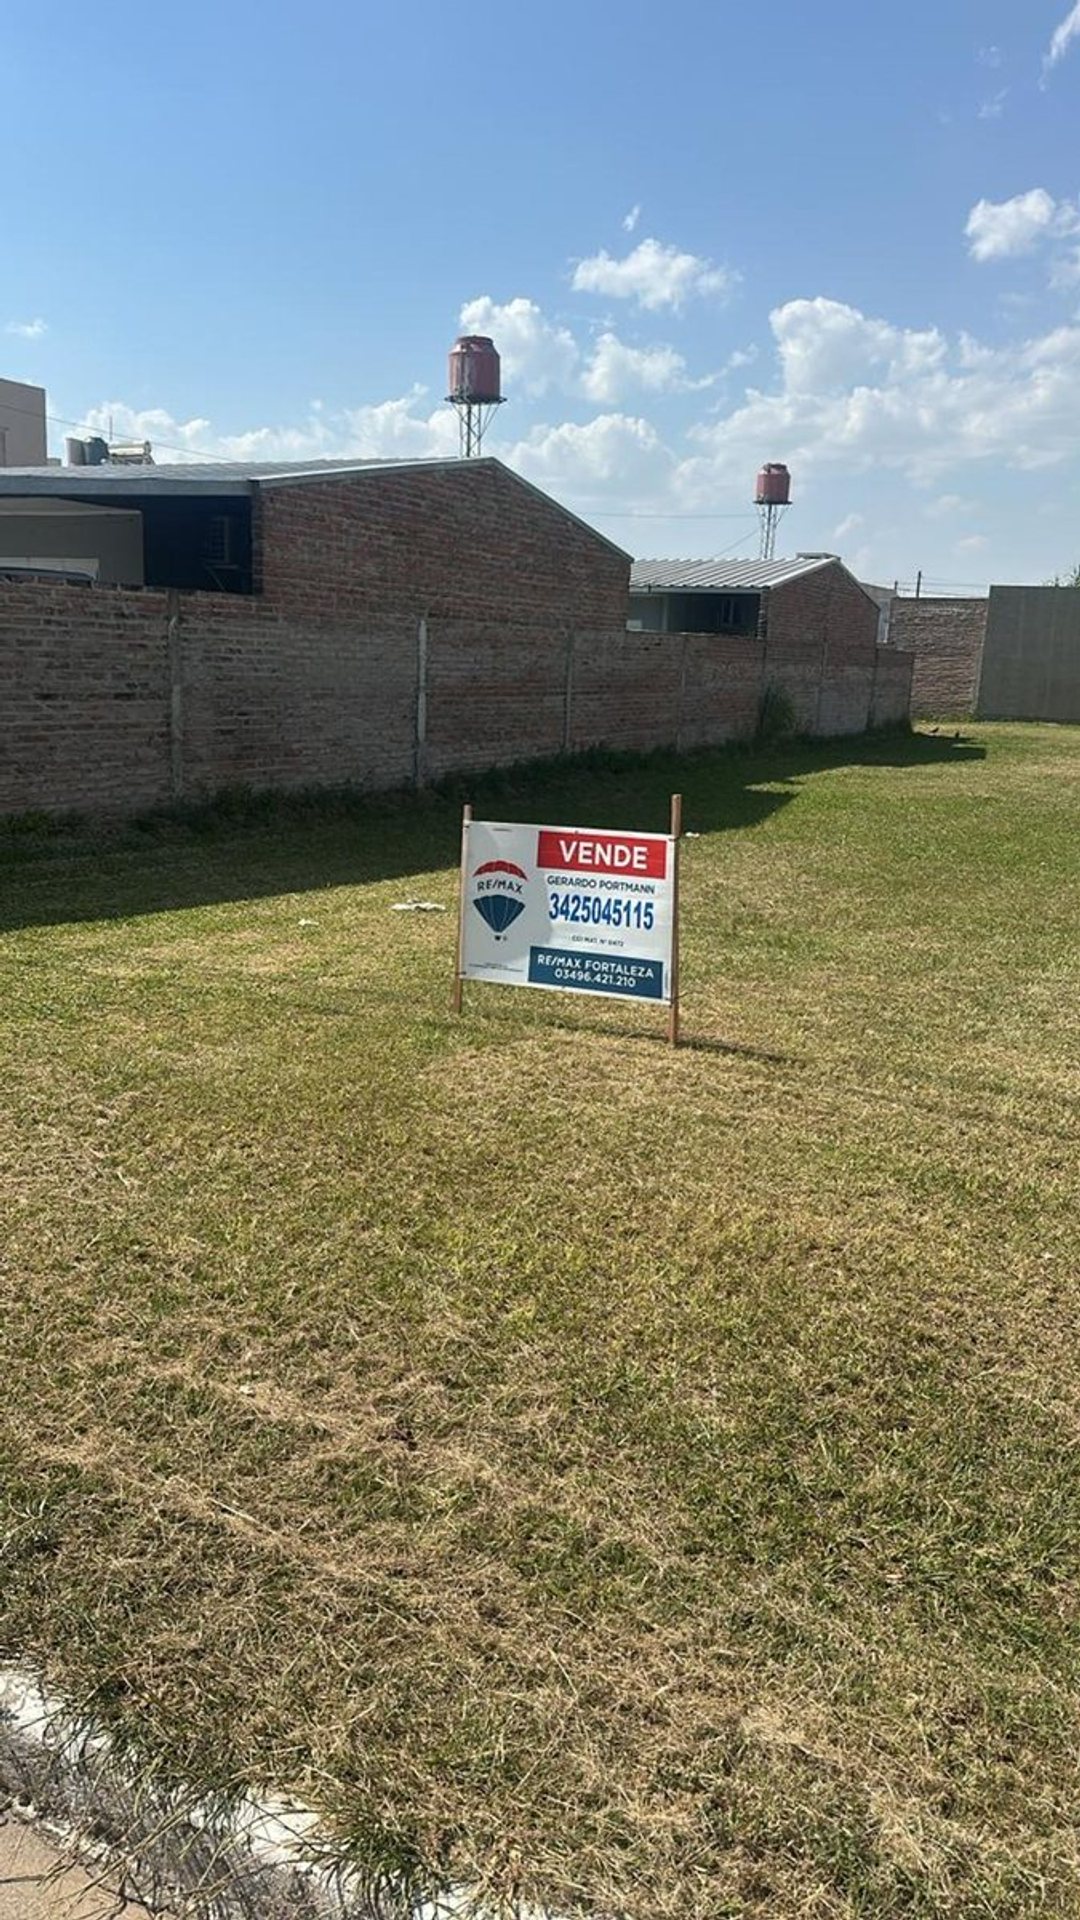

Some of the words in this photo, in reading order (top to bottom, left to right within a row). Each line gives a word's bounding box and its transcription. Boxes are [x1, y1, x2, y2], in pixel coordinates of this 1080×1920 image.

[559, 840, 648, 870] VENDE
[477, 879, 523, 894] RE/MAX
[547, 875, 597, 889] GERARDO
[599, 880, 656, 894] PORTMANN
[548, 893, 654, 930] 3425045115
[537, 954, 582, 969] RE/MAX
[584, 960, 655, 979] FORTALEZA
[554, 968, 637, 988] 03496.421.210
